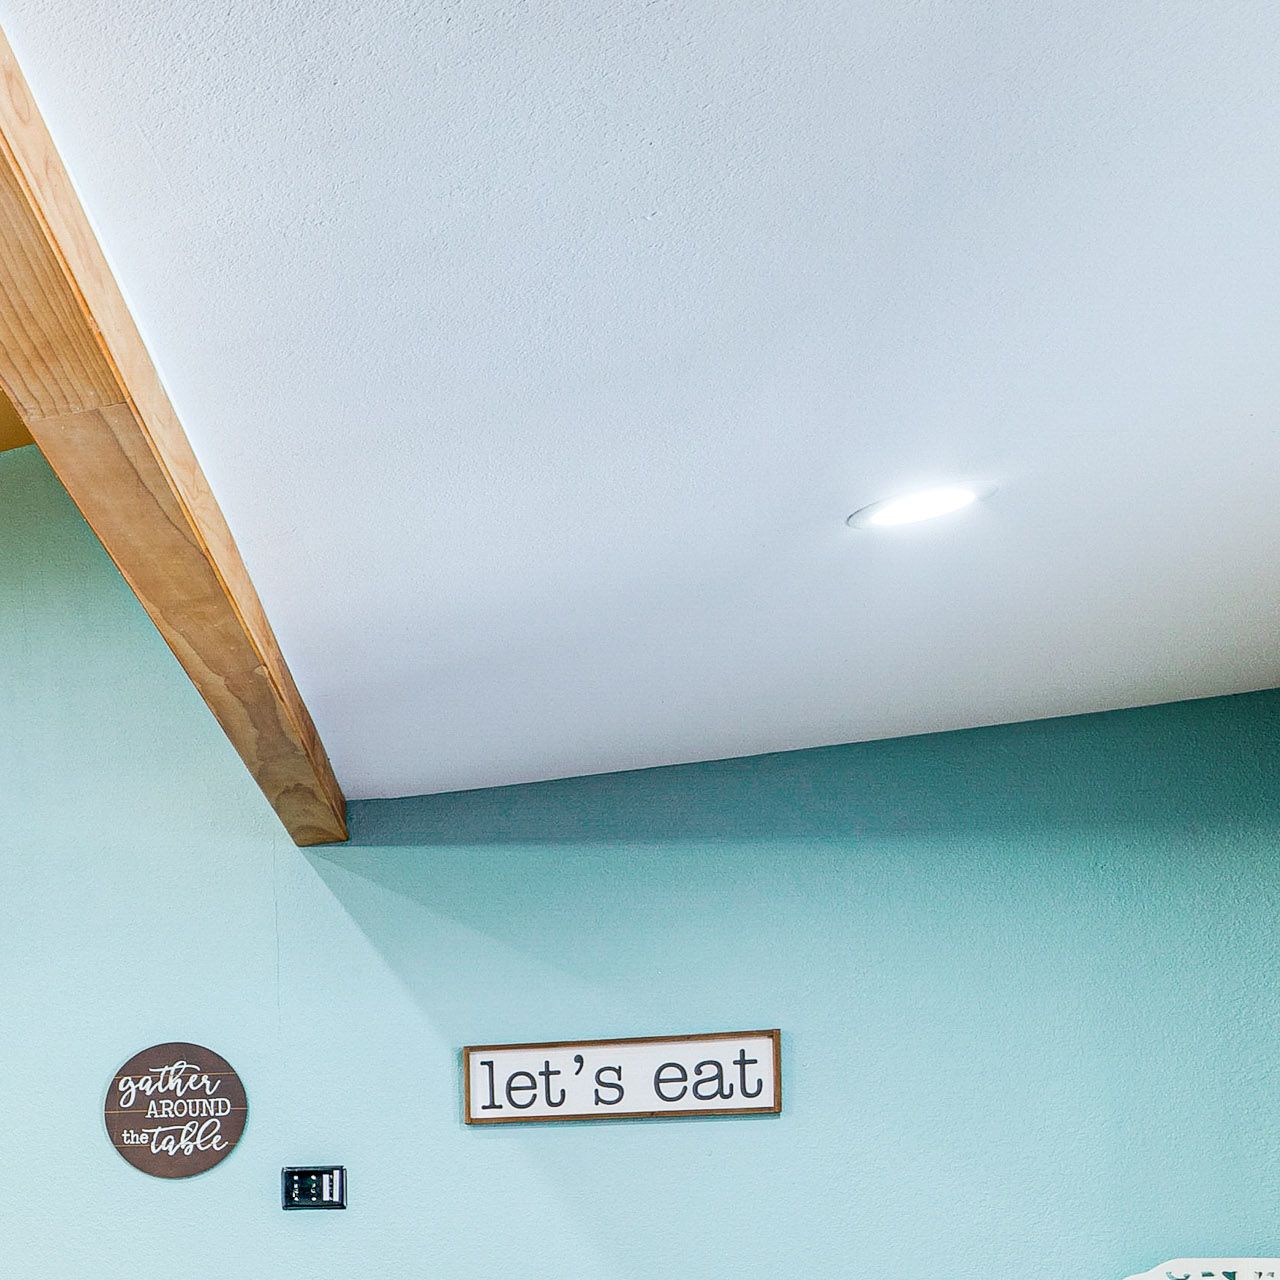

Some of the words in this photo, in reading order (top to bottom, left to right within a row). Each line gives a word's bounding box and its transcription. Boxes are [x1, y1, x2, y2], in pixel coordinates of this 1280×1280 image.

[118, 1060, 221, 1108] gather
[480, 1054, 625, 1110] let's
[654, 1048, 763, 1102] eat
[145, 1097, 231, 1118] AROUND
[122, 1129, 149, 1145] the
[142, 1118, 229, 1156] table
